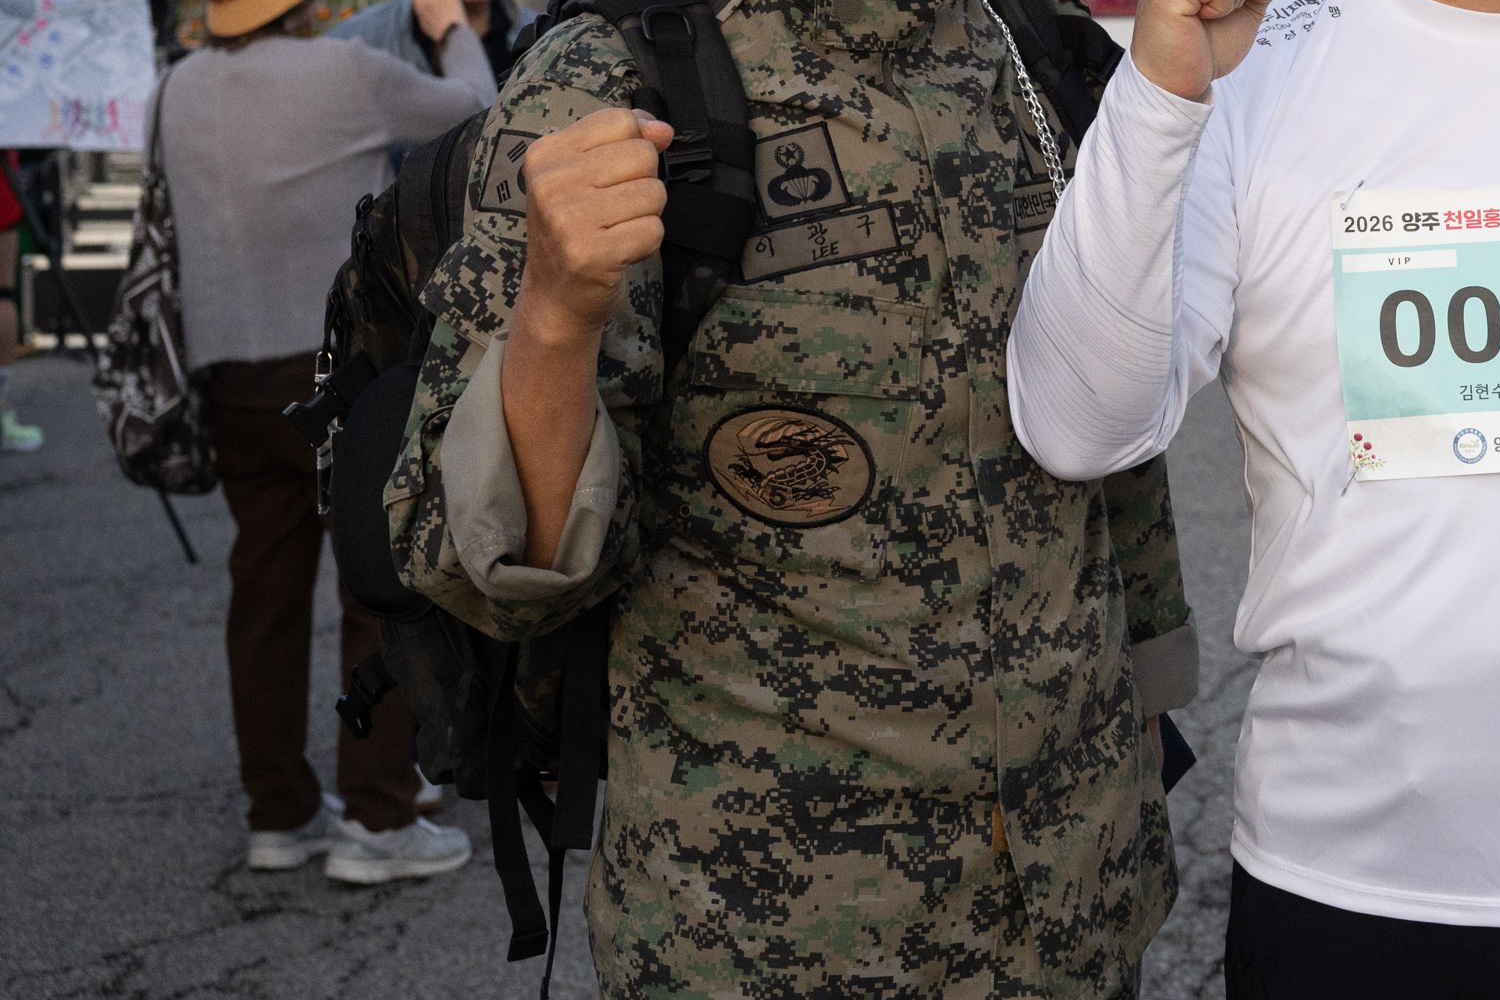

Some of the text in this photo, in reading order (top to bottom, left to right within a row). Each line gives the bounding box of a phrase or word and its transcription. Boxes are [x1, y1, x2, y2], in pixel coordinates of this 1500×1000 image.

[1344, 214, 1394, 233] 2026
[1401, 211, 1441, 232] 양주
[812, 241, 839, 261] LEE
[1388, 257, 1411, 266] VIP
